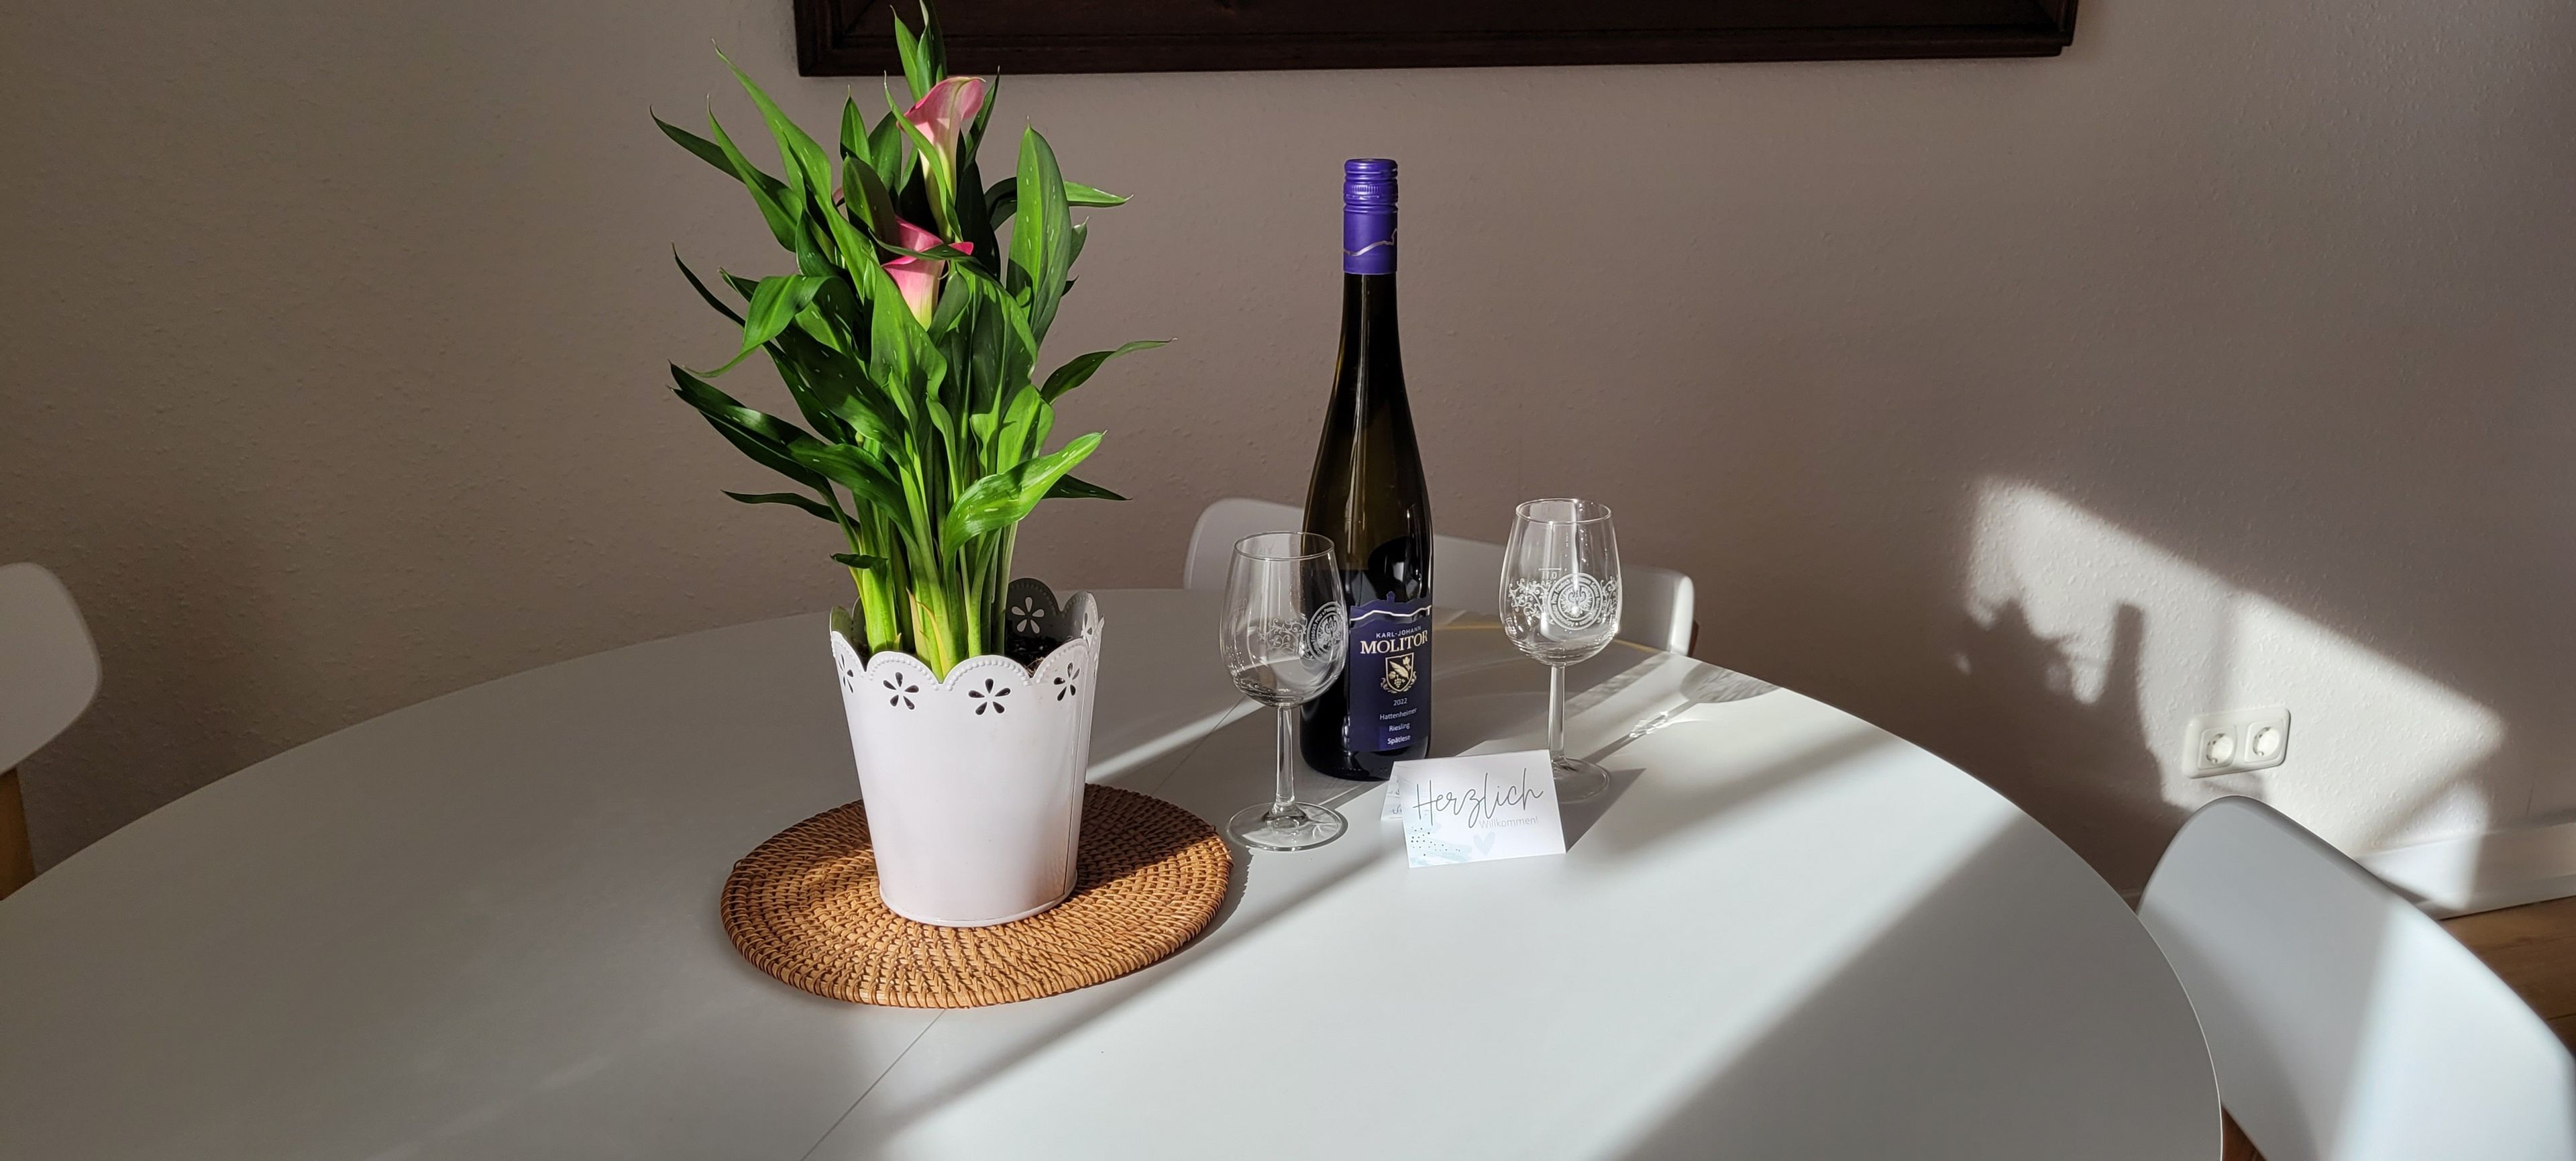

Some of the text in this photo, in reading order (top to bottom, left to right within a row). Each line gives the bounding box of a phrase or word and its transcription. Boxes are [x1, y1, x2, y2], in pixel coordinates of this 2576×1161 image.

[1376, 625, 1421, 638] KARL-JOHANN
[1360, 629, 1428, 654] MOLITOR
[1393, 697, 1408, 706] 2022
[1379, 707, 1417, 721] Hattenheimer
[1389, 723, 1410, 732] Riesling
[1387, 735, 1411, 745] Spätlese
[1412, 767, 1544, 828] Herzlich
[1479, 815, 1538, 829] Willkommen!
